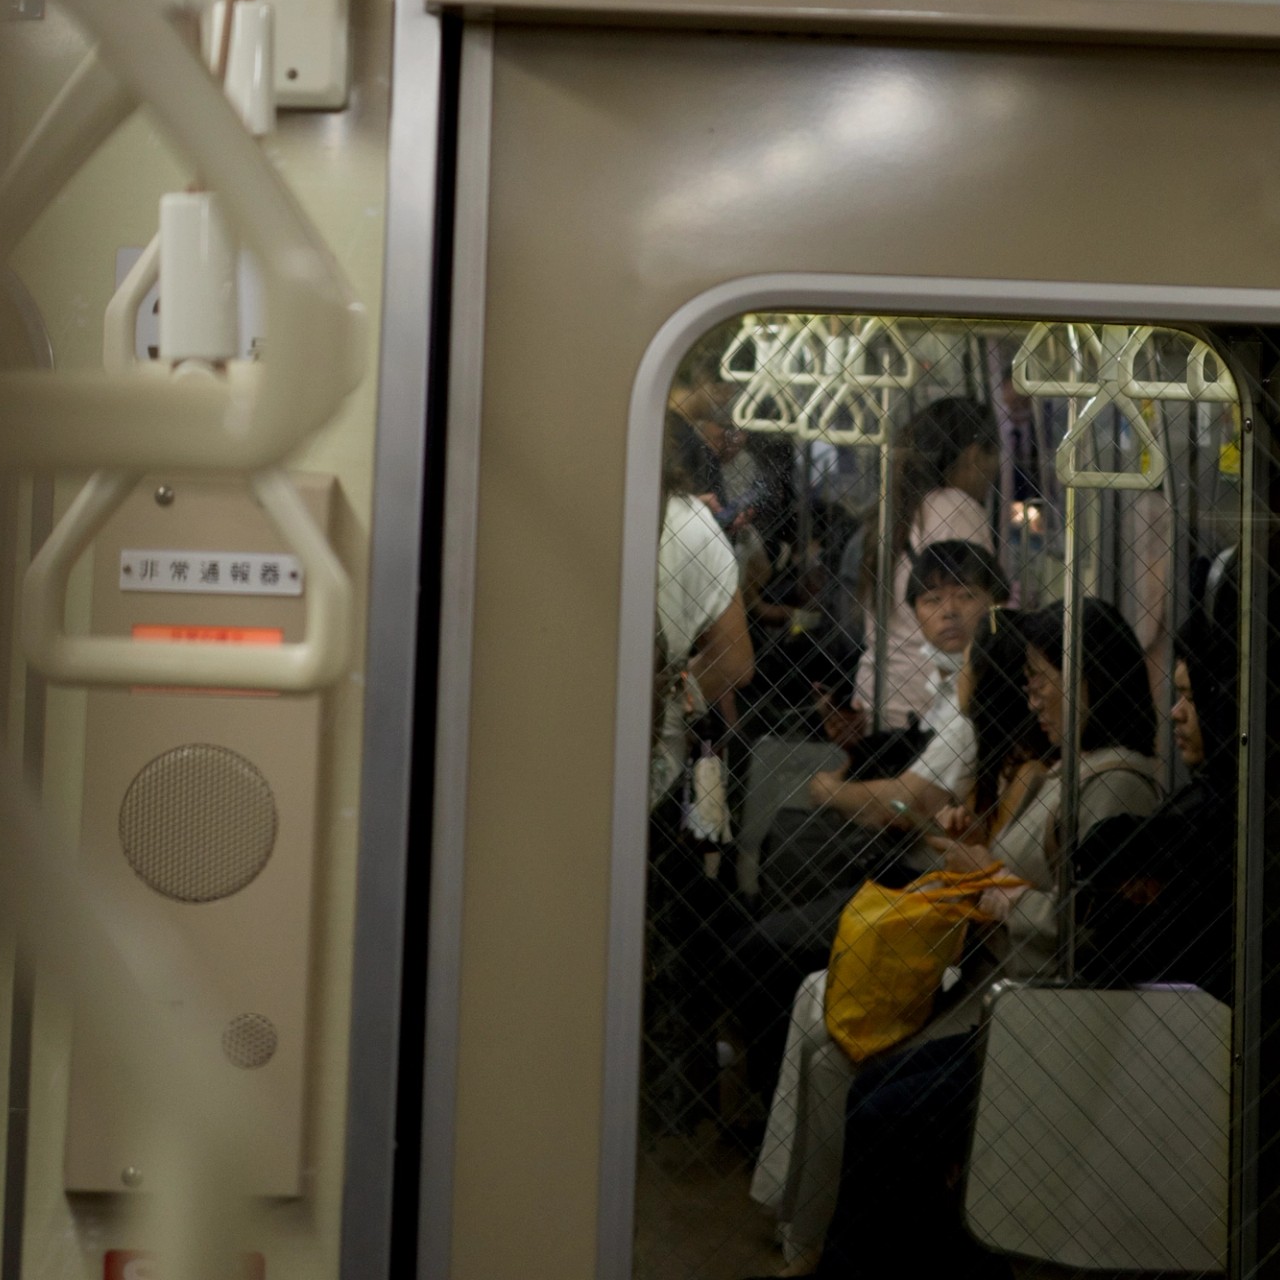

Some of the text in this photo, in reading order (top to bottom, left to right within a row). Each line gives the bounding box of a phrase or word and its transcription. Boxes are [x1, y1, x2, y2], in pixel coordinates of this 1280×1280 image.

[138, 559, 281, 588] 非常通報器
